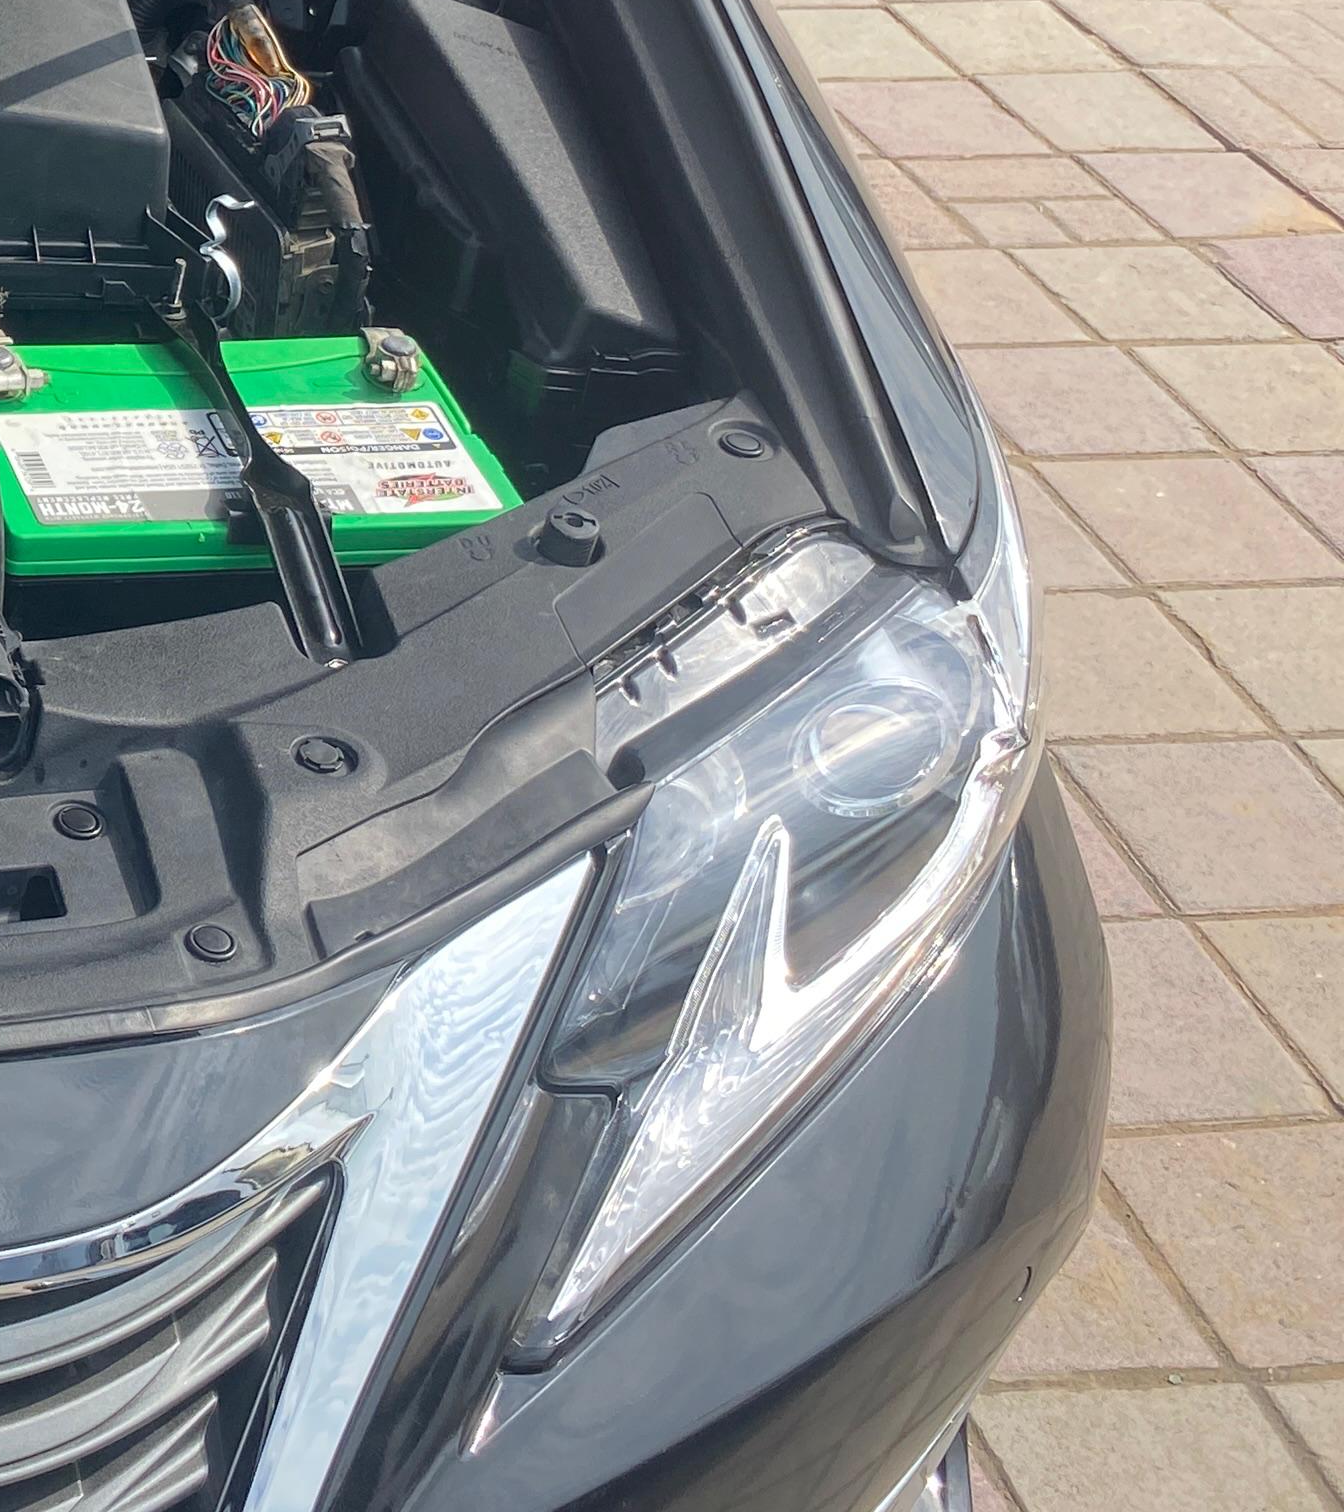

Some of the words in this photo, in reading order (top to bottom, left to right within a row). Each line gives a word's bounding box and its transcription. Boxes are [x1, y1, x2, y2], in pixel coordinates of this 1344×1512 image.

[368, 460, 451, 470] AUTOMOTIVE
[379, 479, 464, 489] BATTERIES
[375, 485, 473, 496] INTERSTATE
[38, 500, 144, 516] 24-MONTH
